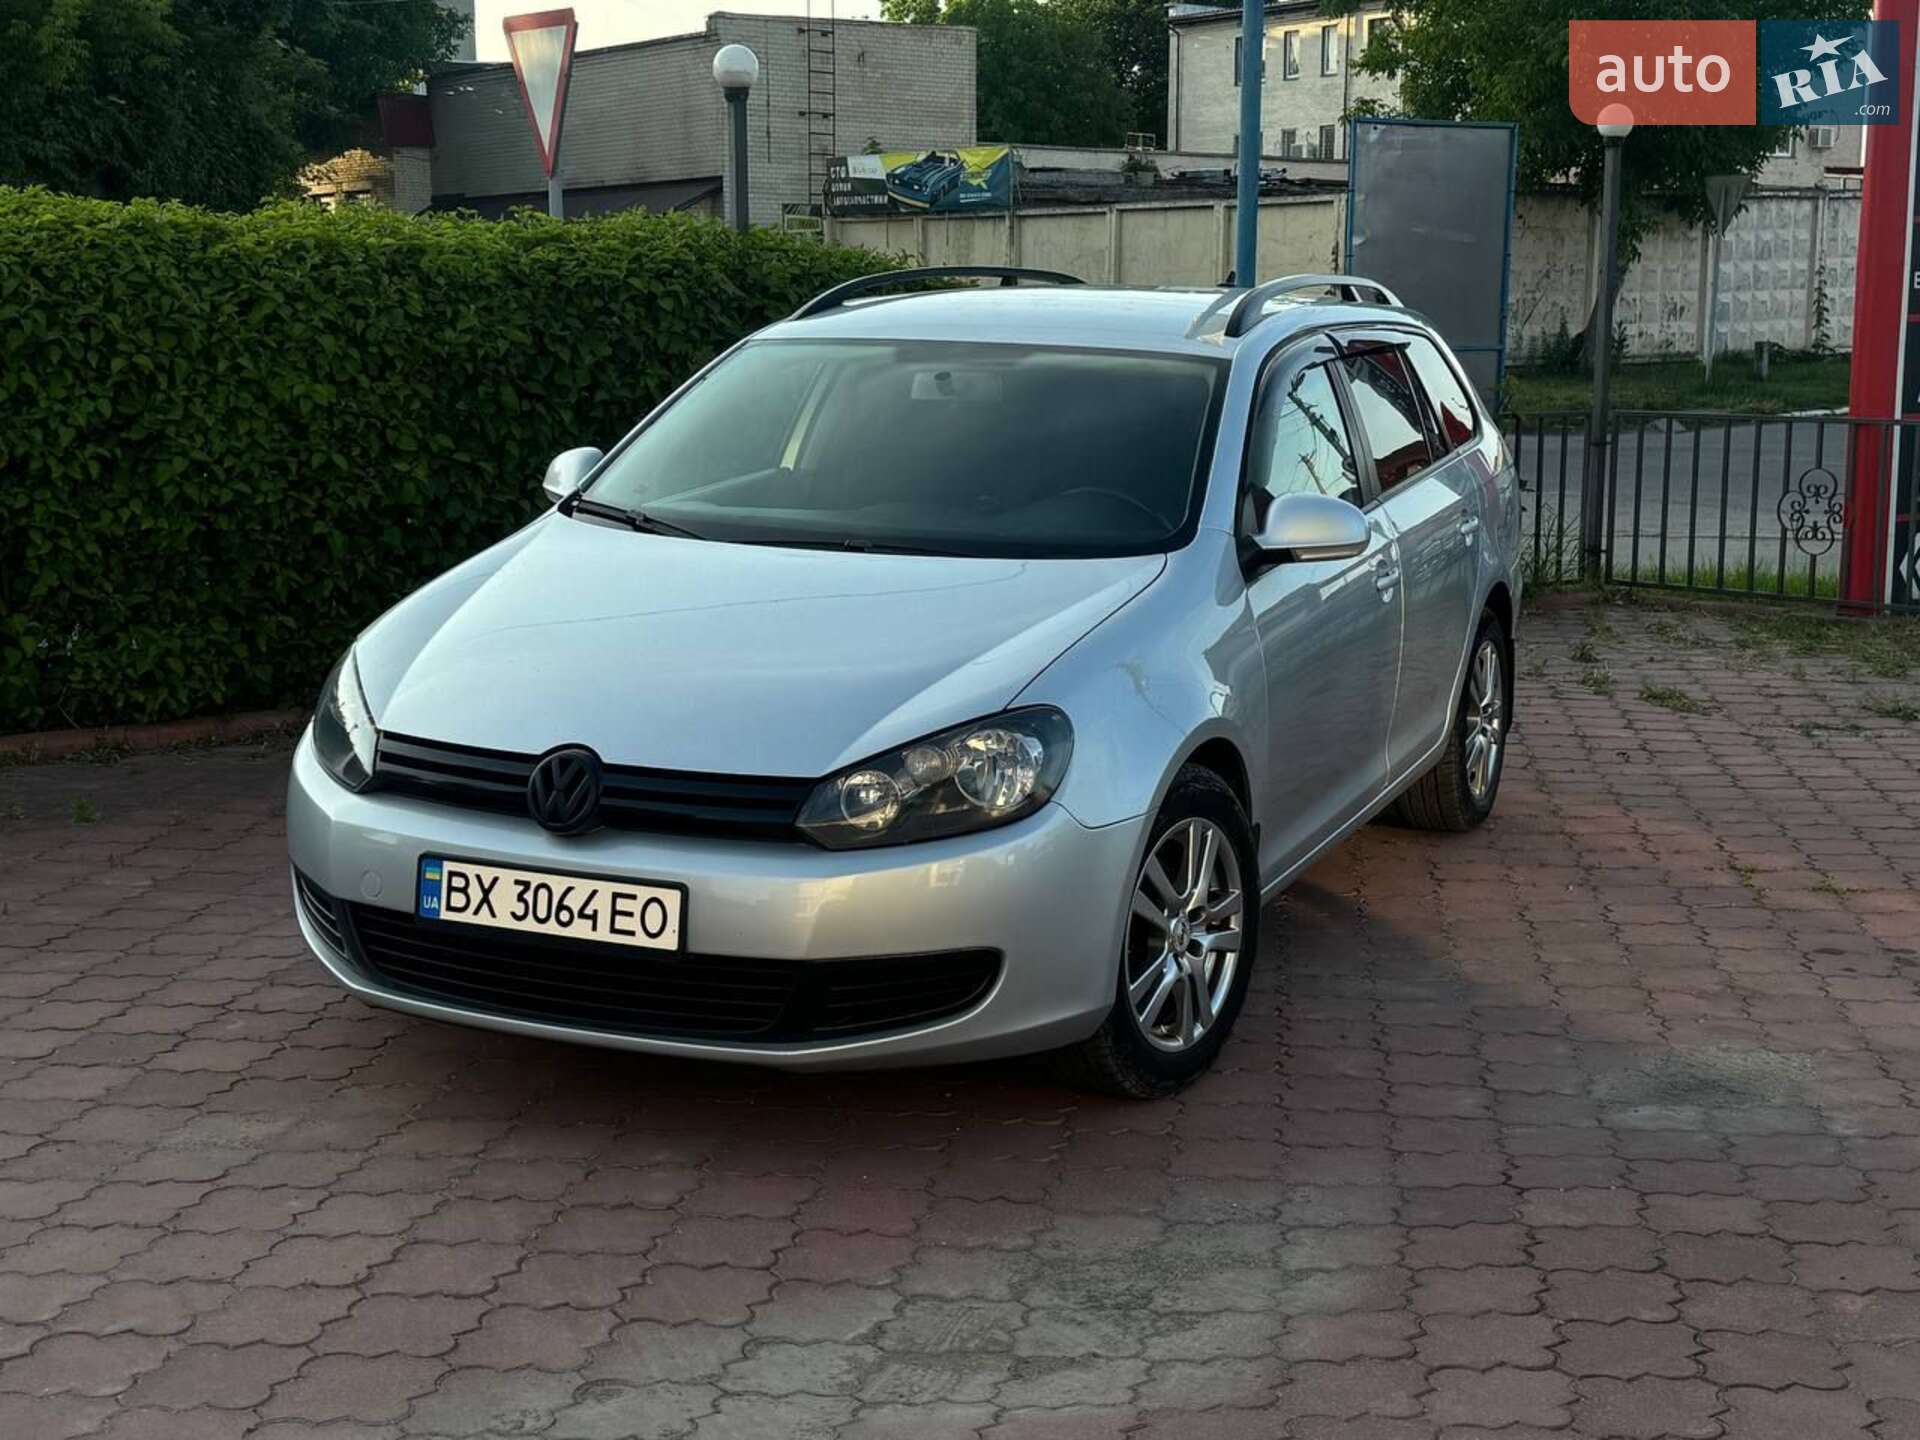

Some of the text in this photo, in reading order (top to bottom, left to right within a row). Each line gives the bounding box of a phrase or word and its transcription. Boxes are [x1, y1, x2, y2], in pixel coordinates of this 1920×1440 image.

[423, 895, 439, 909] UA
[446, 870, 668, 939] BX 3064 EO
